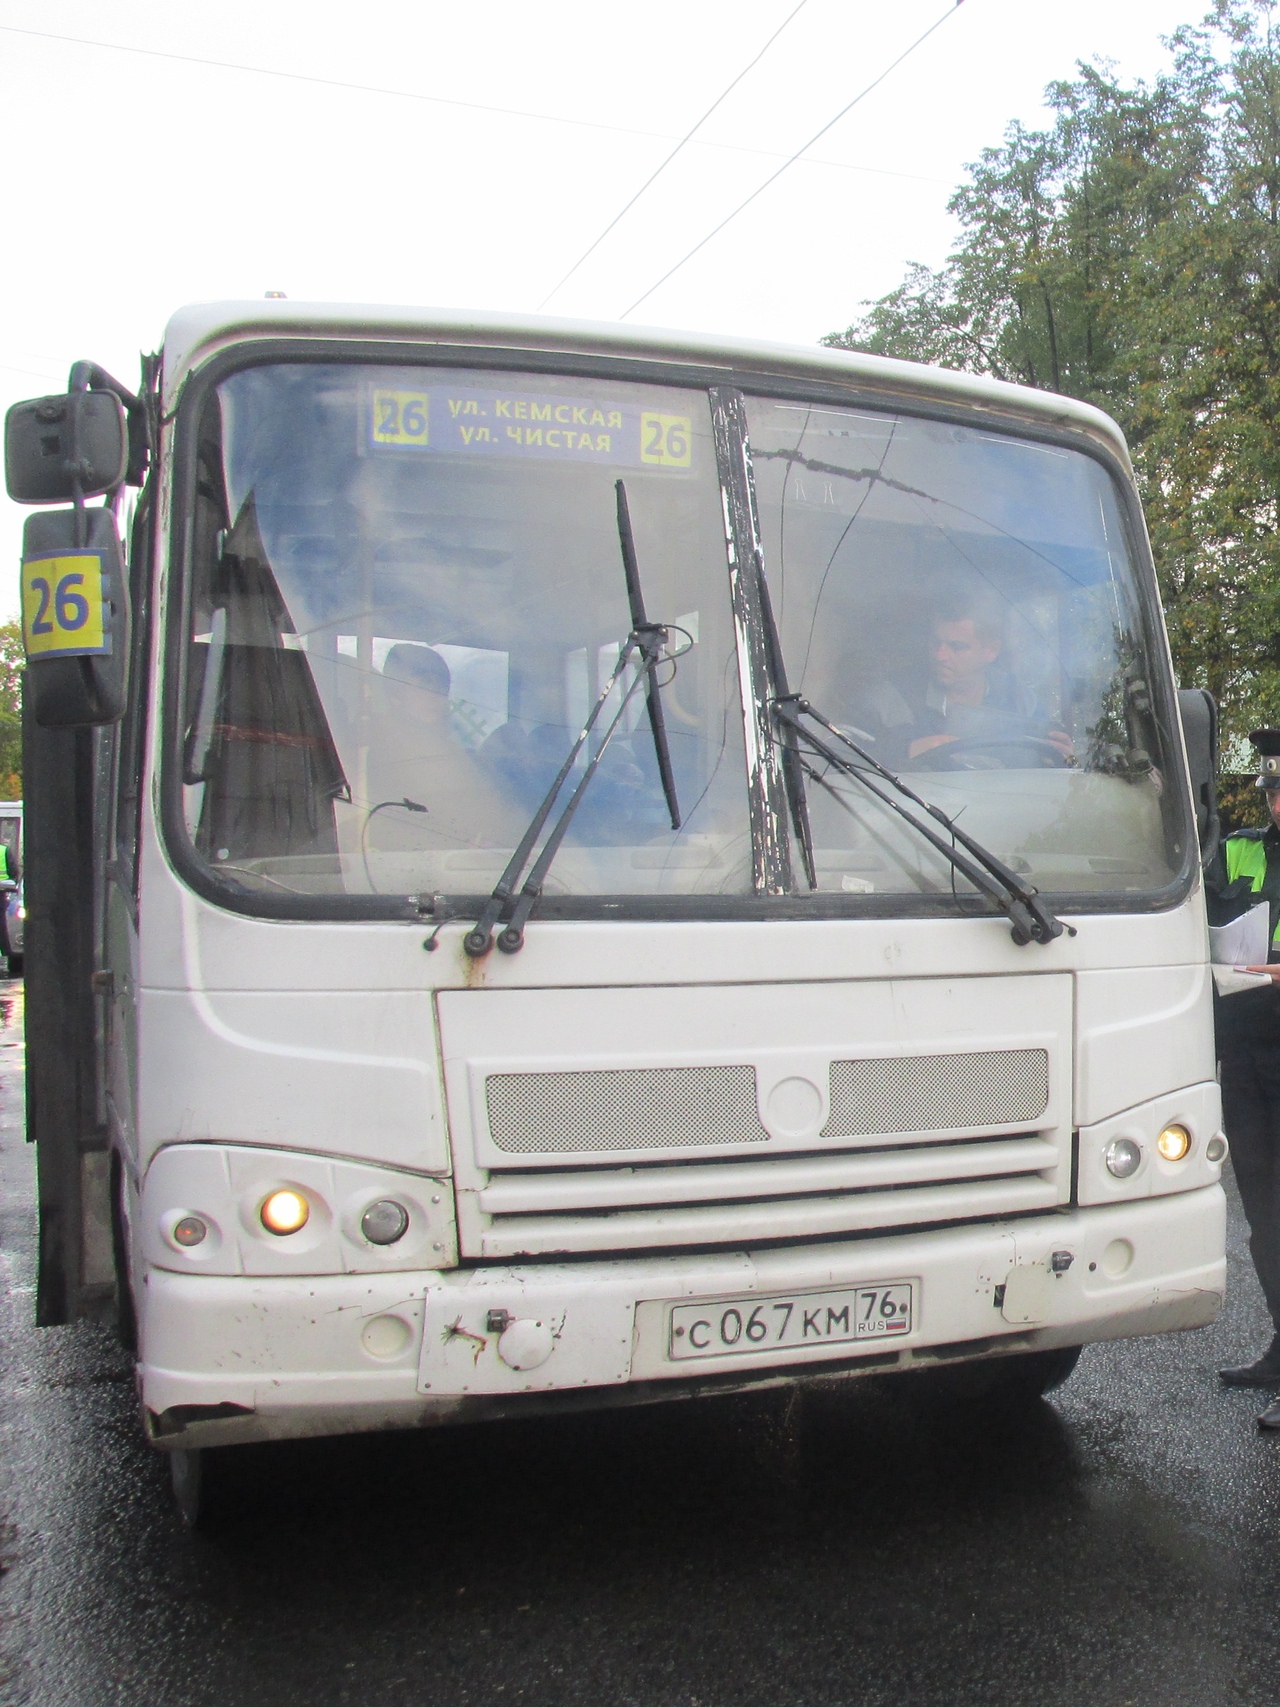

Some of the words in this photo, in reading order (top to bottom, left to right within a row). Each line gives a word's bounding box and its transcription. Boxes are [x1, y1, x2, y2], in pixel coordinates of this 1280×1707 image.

[378, 397, 427, 437] 26
[447, 398, 487, 418] ул.
[495, 399, 622, 428] КЕМСКАЯ
[460, 426, 499, 445] ул.
[506, 426, 612, 452] ЧИСТАЯ
[645, 420, 687, 459] 26
[30, 572, 90, 636] 26
[860, 1289, 898, 1321] 76
[858, 1320, 886, 1333] RUS
